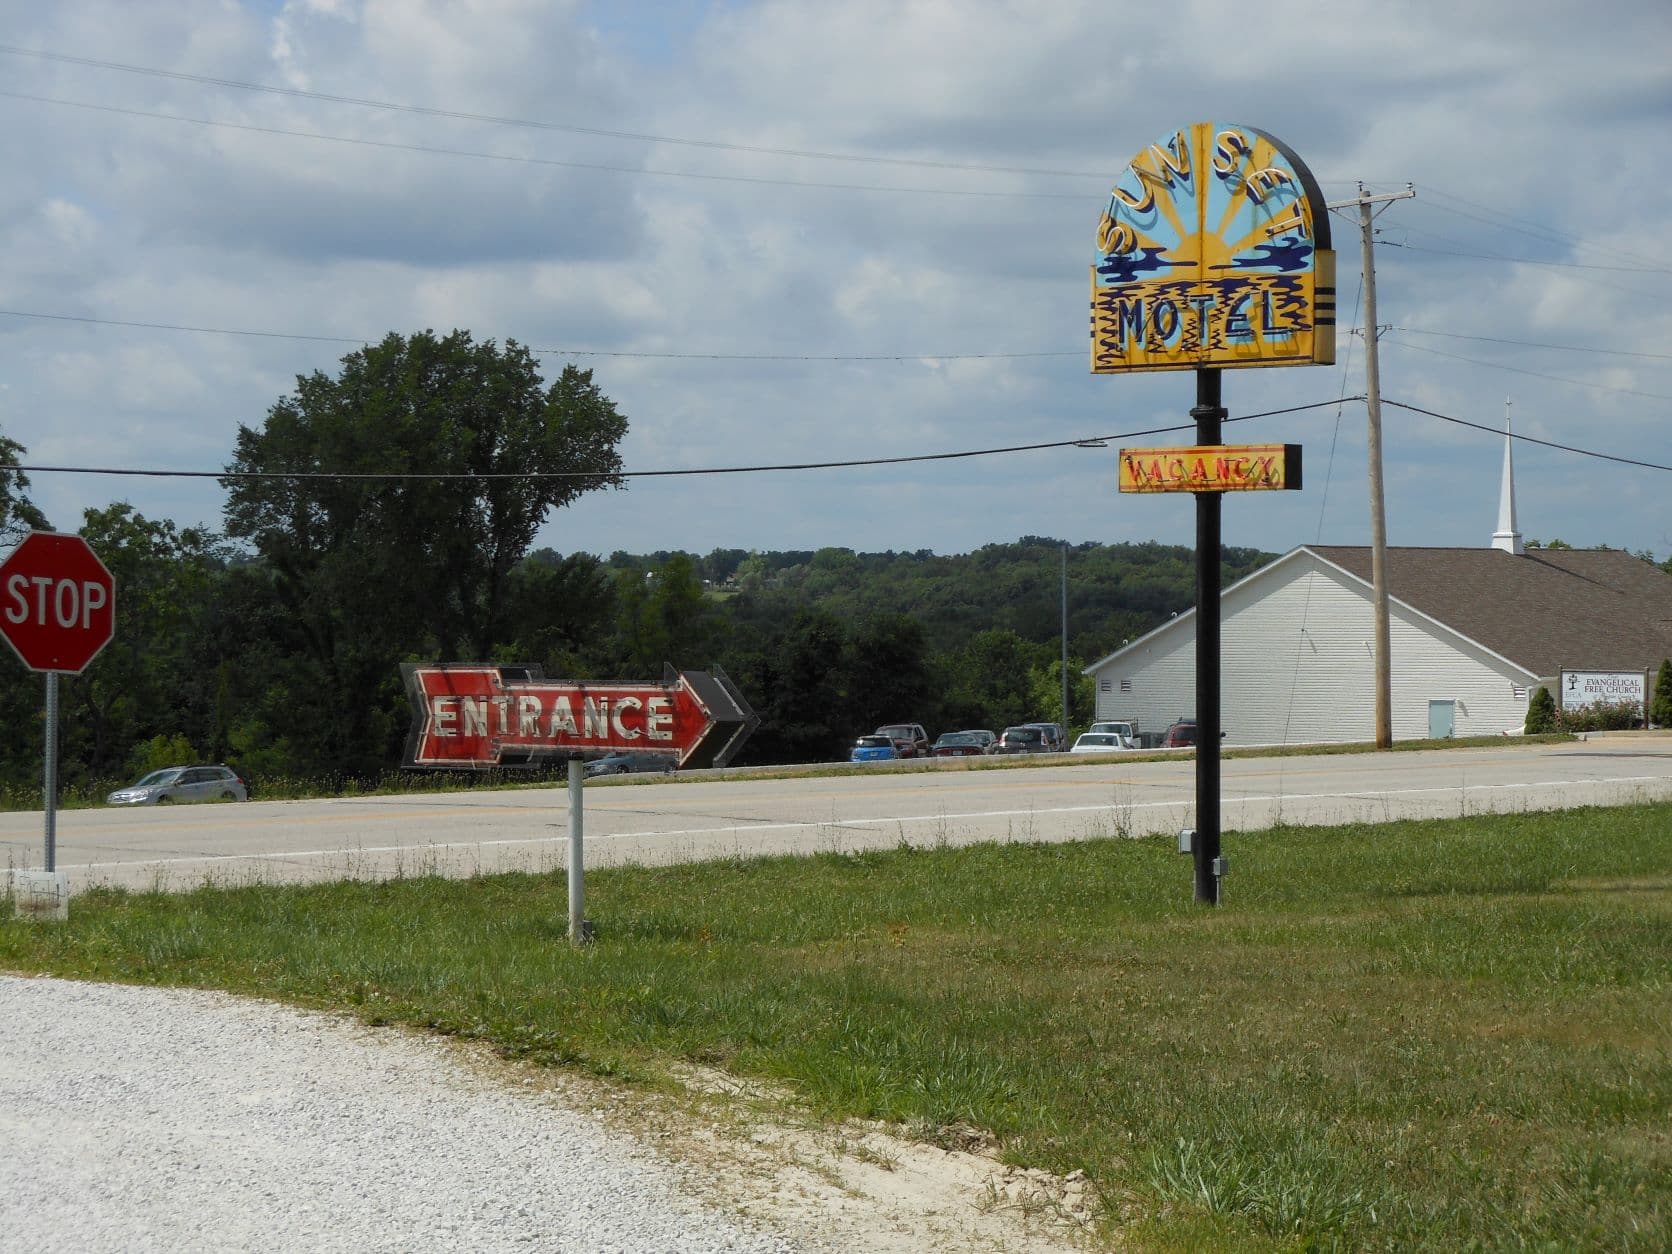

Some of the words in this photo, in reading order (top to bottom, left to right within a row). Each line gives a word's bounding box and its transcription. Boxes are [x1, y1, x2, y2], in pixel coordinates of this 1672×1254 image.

[1118, 290, 1295, 346] MOTEL
[1127, 455, 1275, 484] VACANCY
[5, 574, 107, 629] STOP
[1586, 679, 1640, 687] EVANGELICAL
[1606, 686, 1641, 694] CHURCH
[432, 695, 673, 740] ENTRANCE
